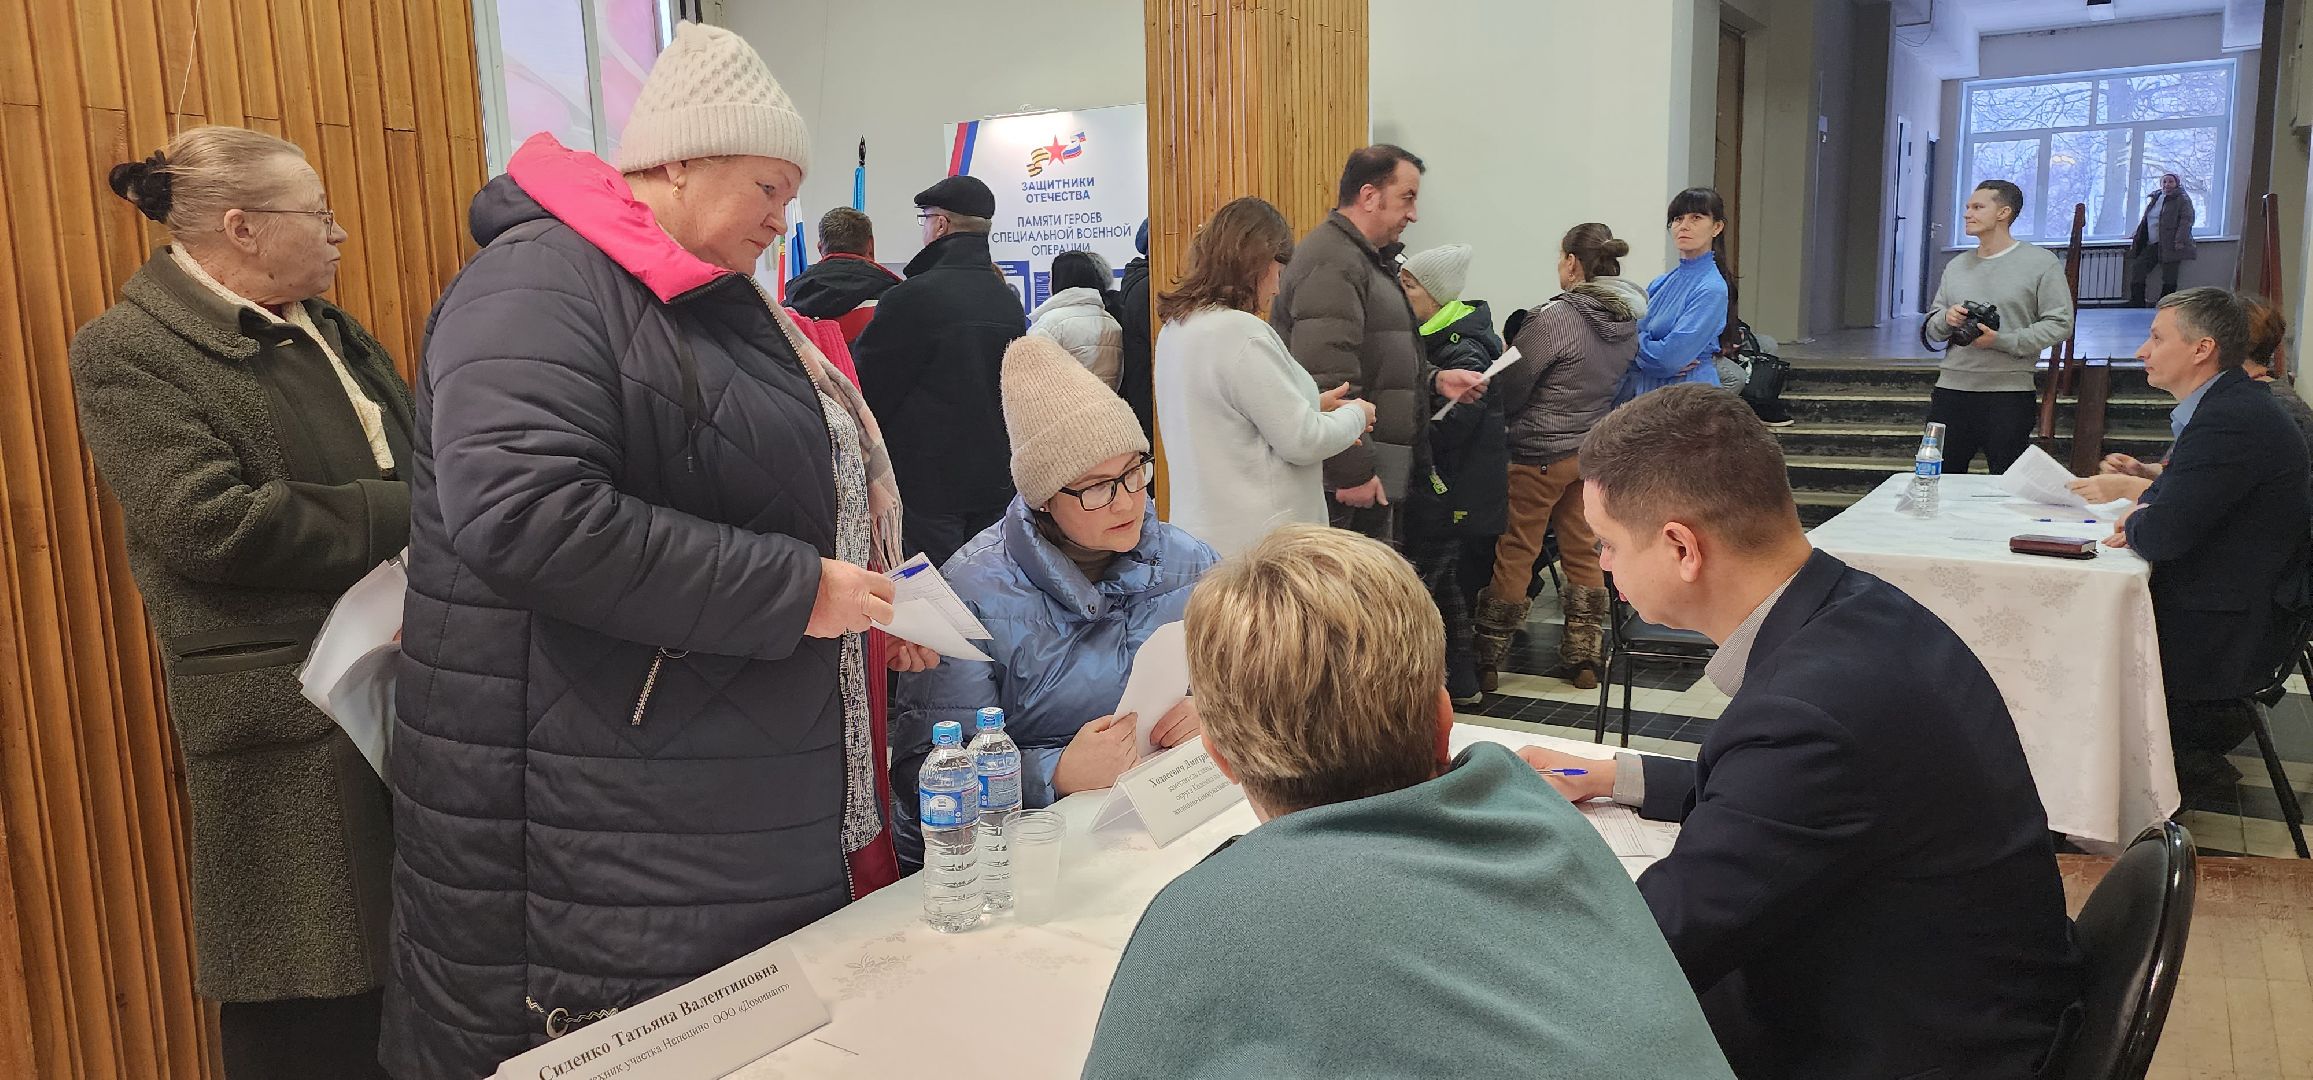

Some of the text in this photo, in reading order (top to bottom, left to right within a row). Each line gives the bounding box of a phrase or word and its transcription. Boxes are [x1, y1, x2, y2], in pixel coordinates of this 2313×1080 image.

[1021, 177, 1095, 191] ЗАЩИТНИКИ
[1026, 190, 1091, 203] ОТЕЧЕСТВА
[1017, 212, 1103, 227] ПАМЯТИ ГЕРОЕВ
[992, 223, 1132, 243] СПЕЦИАЛЬНОЙ ВОЕННОЙ
[540, 963, 779, 1080] Сиденко Татьяна Валентиновна
[623, 1045, 662, 1072] участка
[712, 1007, 737, 1024] ООО
